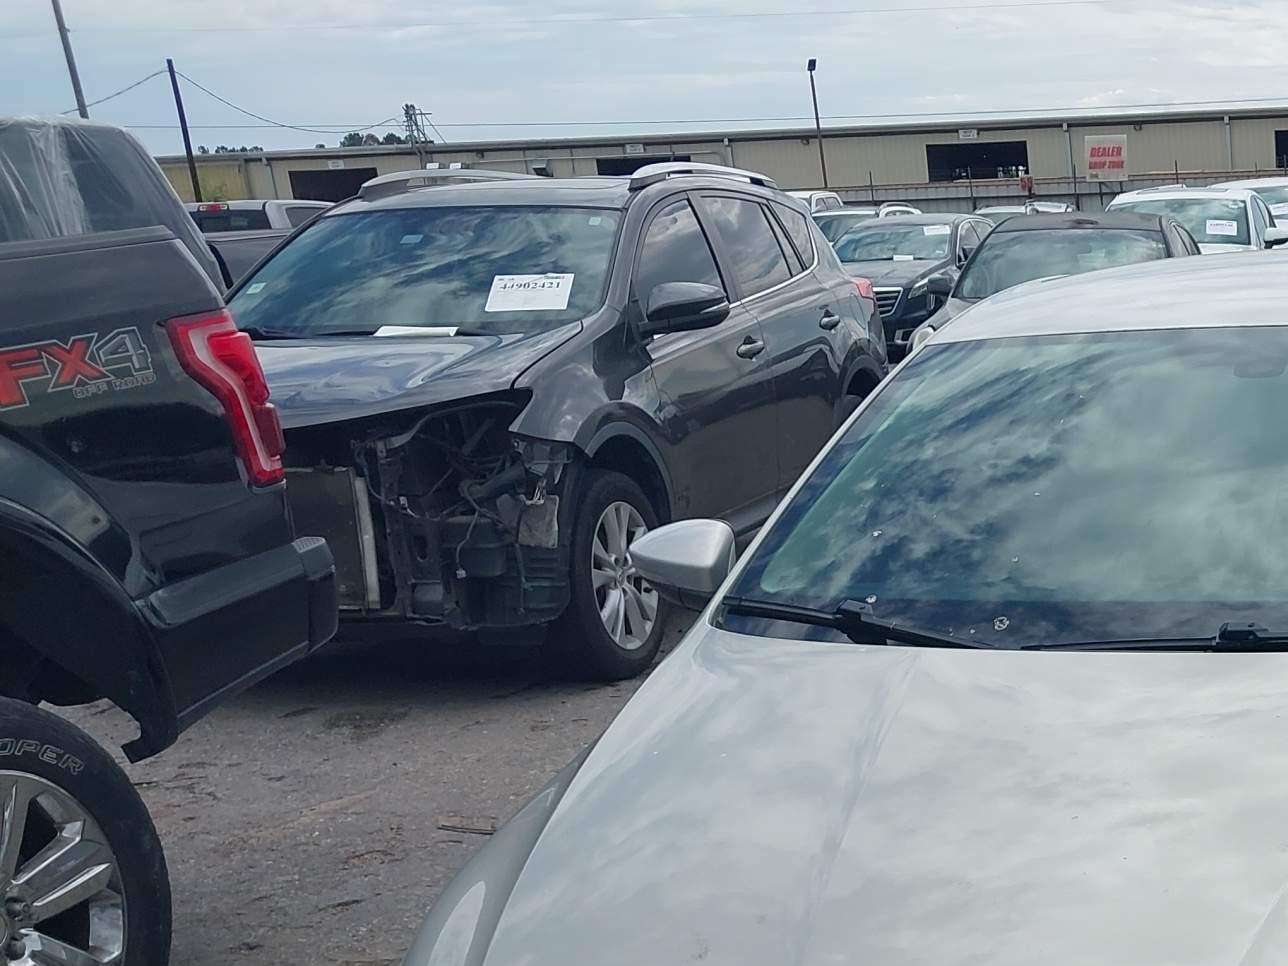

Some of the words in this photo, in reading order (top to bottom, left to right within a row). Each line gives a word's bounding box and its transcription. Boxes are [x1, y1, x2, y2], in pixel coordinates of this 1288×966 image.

[1090, 146, 1122, 158] DEALER
[500, 281, 562, 290] 44902421
[0, 327, 153, 411] FX4
